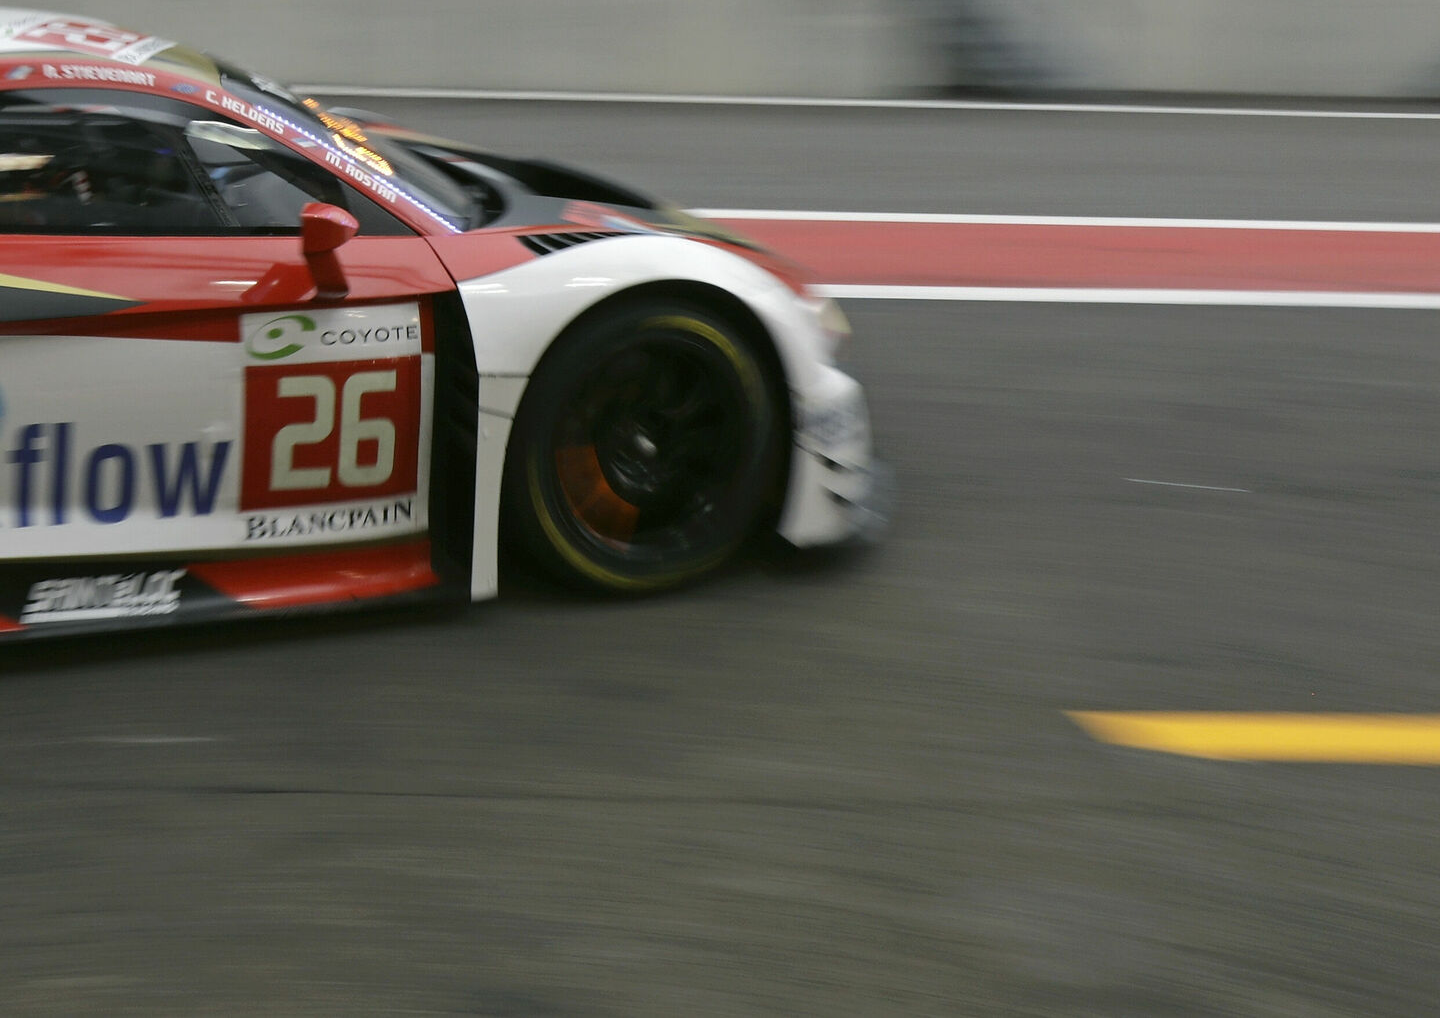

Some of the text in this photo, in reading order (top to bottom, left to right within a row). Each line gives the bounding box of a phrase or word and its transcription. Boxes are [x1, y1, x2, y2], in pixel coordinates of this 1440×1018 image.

[205, 89, 220, 105] C.
[320, 324, 418, 347] COYOTE
[268, 368, 398, 492] 26
[243, 499, 415, 541] BLANCPAIN
